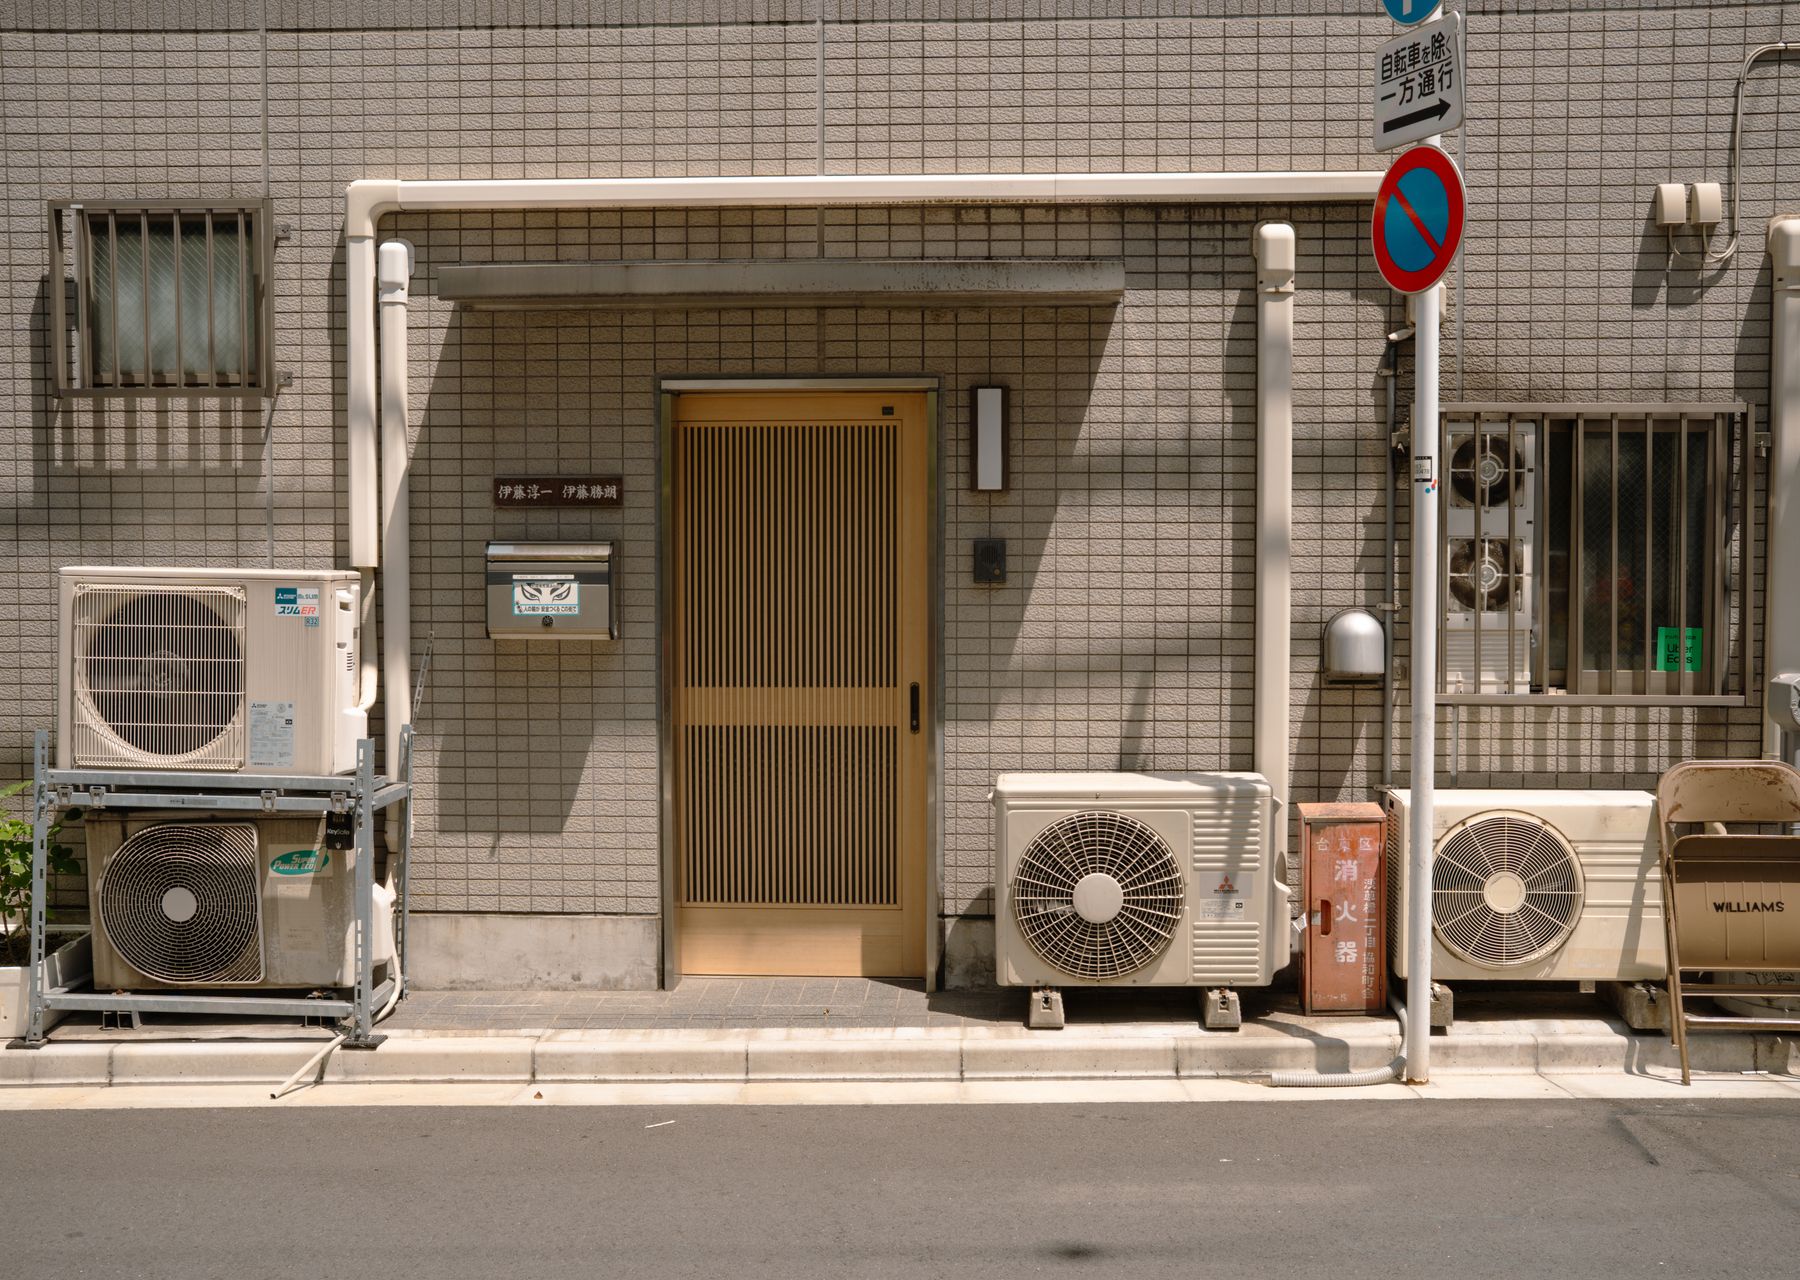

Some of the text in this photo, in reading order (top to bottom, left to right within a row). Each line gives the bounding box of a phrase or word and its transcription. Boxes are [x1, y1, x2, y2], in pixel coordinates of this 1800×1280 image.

[1381, 31, 1452, 81] 自転車を除く
[1381, 61, 1453, 106] 一方通行
[498, 484, 553, 500] 伊藤淳一
[1667, 643, 1693, 654] Uber
[1666, 653, 1694, 664] Eas
[1316, 831, 1373, 853] 台東区
[1334, 860, 1358, 963] 消火器
[1713, 901, 1785, 913] WILLIAMS
